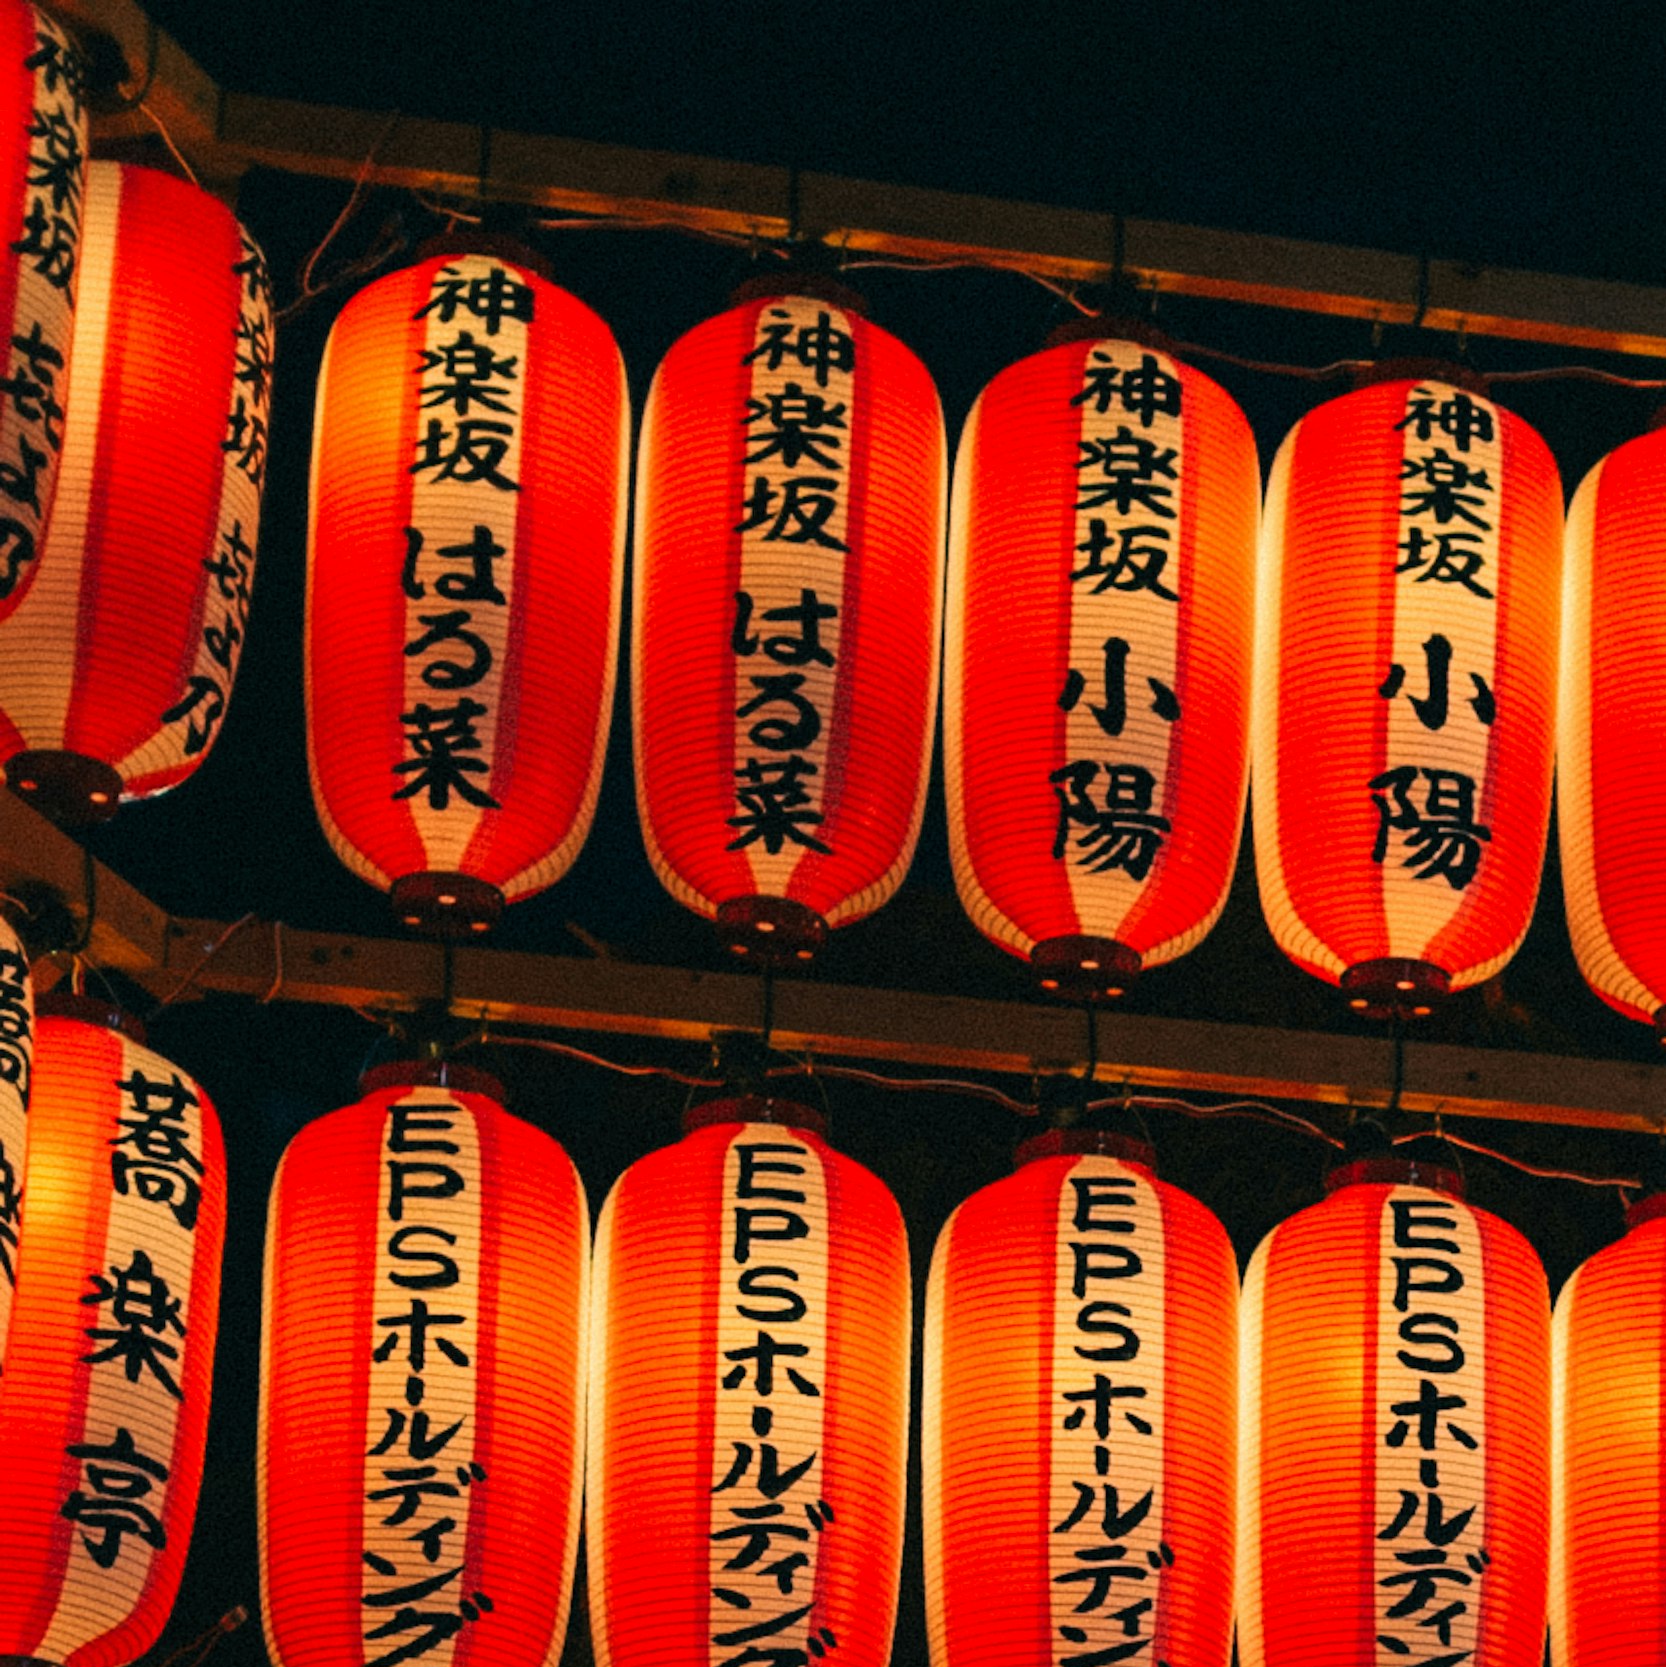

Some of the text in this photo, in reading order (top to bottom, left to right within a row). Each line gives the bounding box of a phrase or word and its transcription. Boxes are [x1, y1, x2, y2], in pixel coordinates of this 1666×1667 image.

[391, 266, 534, 810] 神楽坂 はる菜
[725, 309, 855, 855] 神楽坂 はる菜
[1048, 352, 1182, 880] 神楽坂 小陽
[1366, 387, 1495, 891] 神楽坂 小陽
[59, 1072, 204, 1568] 蕎楽亭
